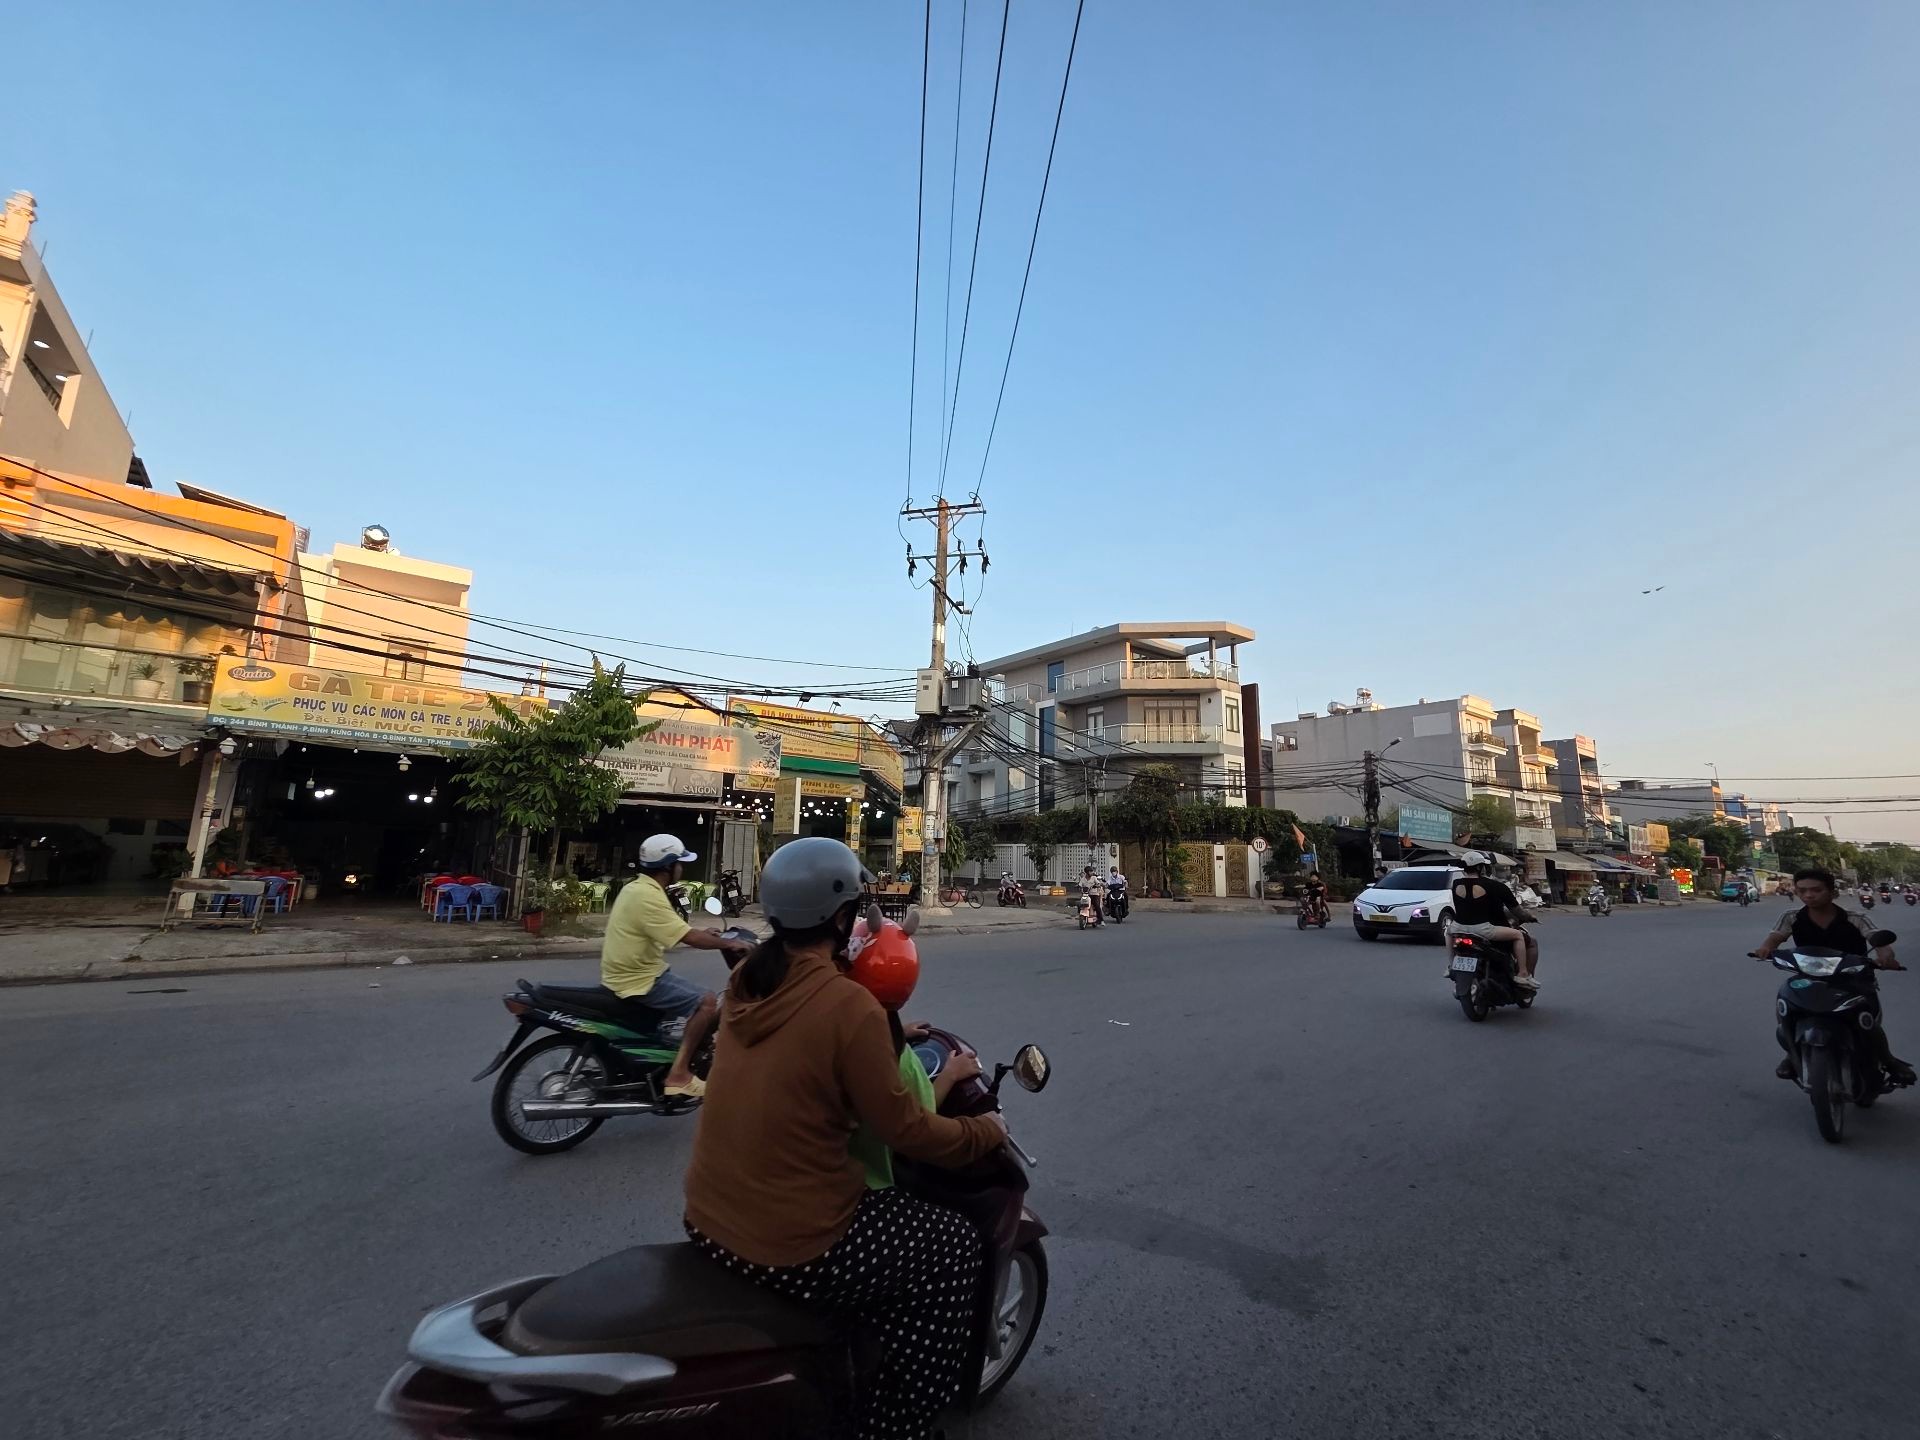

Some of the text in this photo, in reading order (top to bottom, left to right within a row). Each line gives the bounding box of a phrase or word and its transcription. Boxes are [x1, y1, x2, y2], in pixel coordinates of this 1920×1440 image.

[288, 672, 353, 697] GÀ
[365, 681, 447, 708] TRE
[293, 696, 326, 713] PHỤC
[332, 702, 348, 716] VỤ
[353, 702, 377, 717] CÁC
[431, 712, 451, 726] TRE
[455, 716, 463, 727] &
[688, 734, 735, 753] PHÁT
[682, 784, 718, 796] SAIGON
